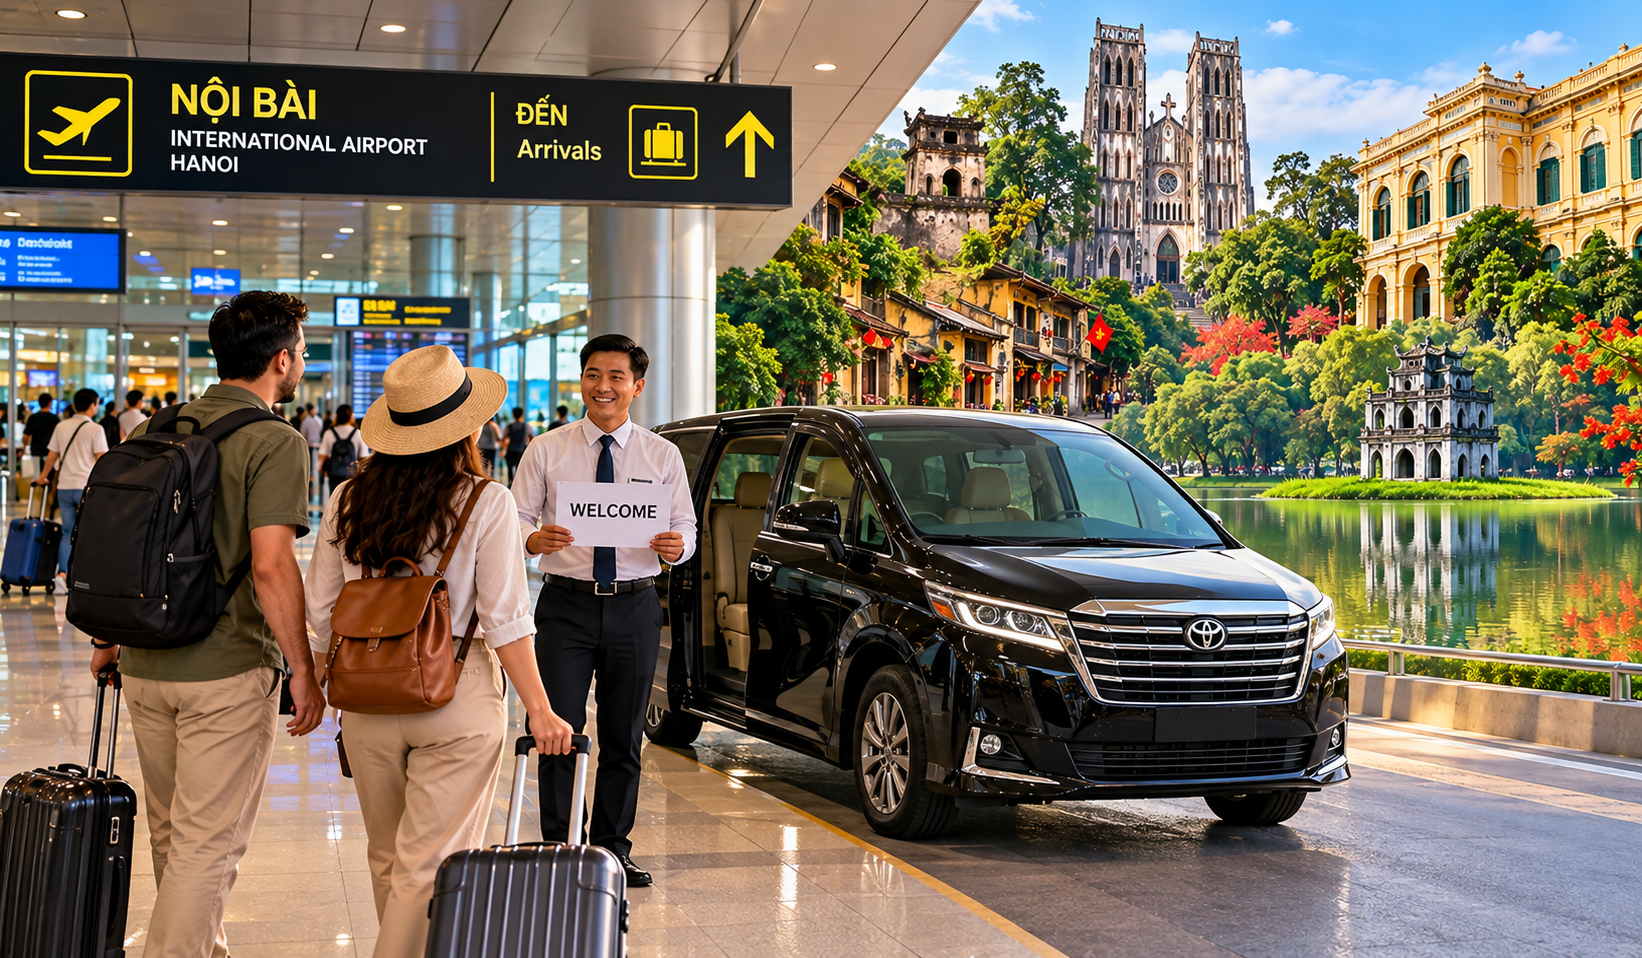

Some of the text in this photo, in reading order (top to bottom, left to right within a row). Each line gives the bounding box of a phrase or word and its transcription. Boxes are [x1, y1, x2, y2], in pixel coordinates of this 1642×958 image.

[171, 76, 317, 124] NỘI BÀI
[515, 93, 568, 127] ĐẾN
[170, 129, 429, 155] INTERNATIONAL AIRPORT
[517, 138, 602, 161] Arrivals
[170, 153, 239, 173] HANOI
[569, 502, 658, 519] WELCOME
